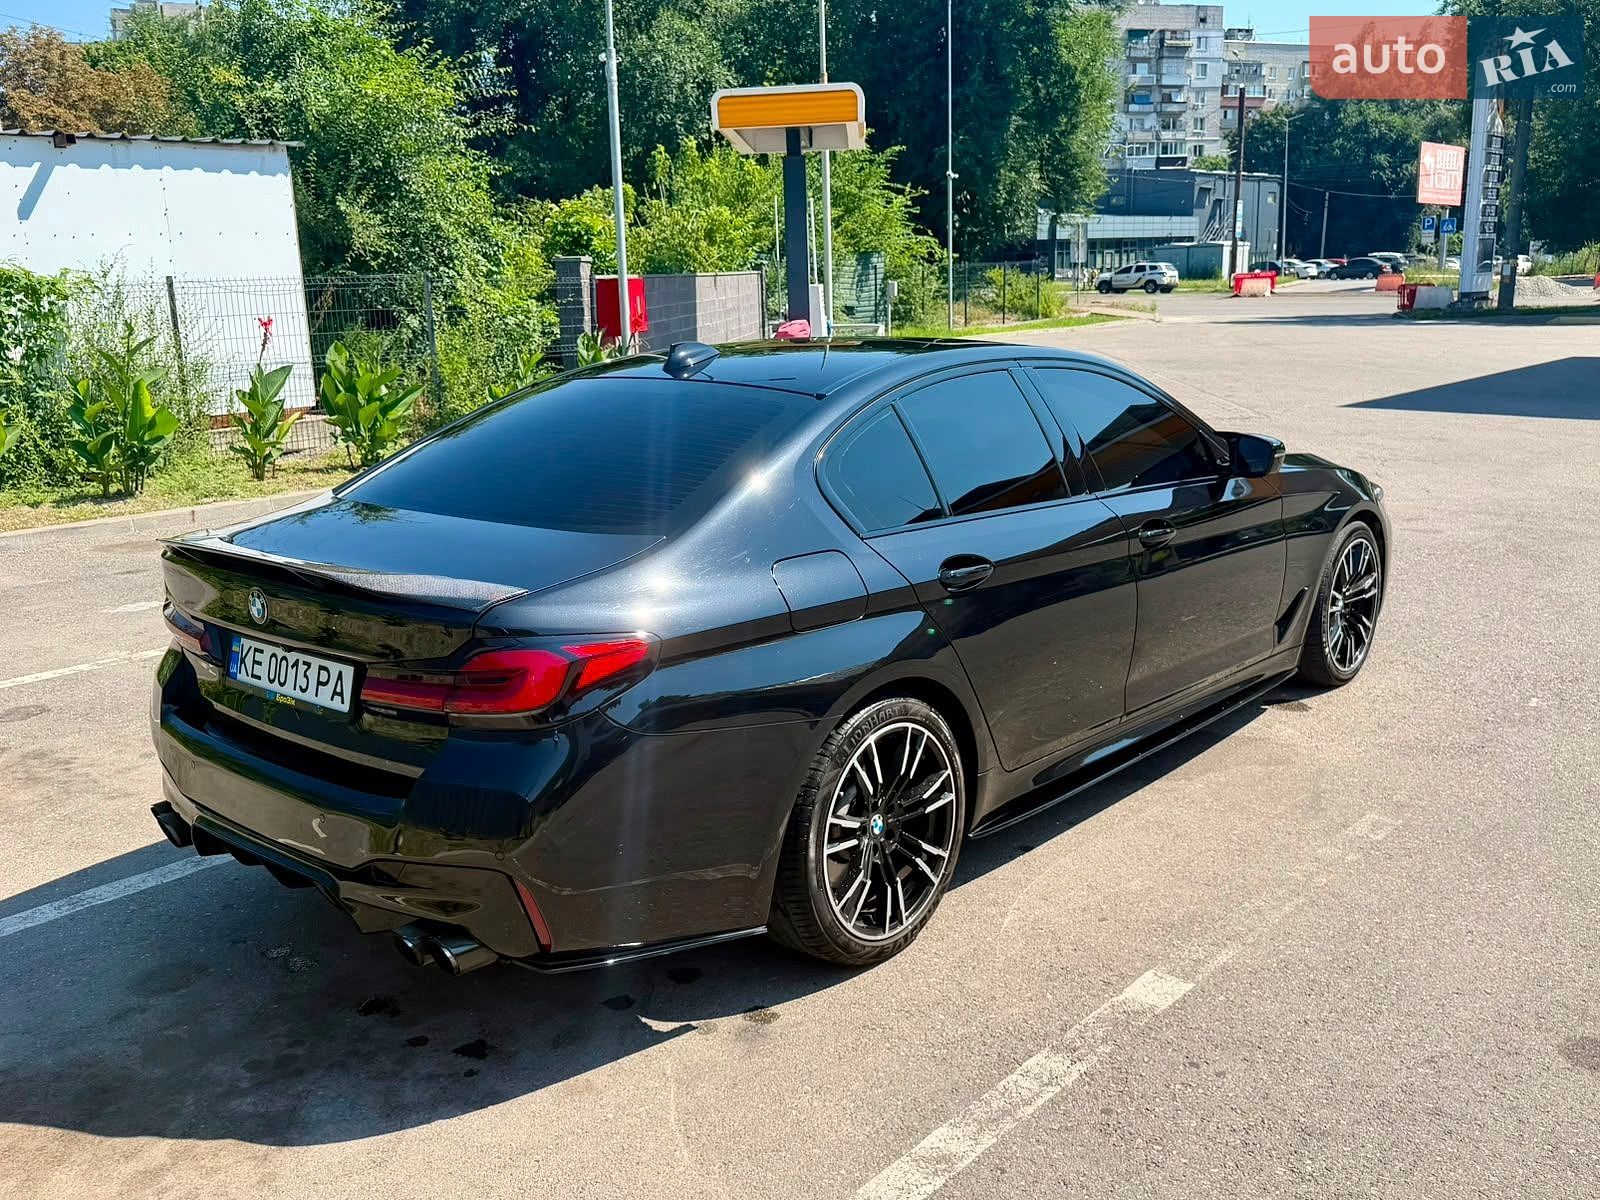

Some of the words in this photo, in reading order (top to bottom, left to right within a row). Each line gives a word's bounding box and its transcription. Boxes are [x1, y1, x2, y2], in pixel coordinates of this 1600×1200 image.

[1424, 218, 1433, 229] P
[239, 643, 265, 681] KE
[267, 652, 312, 694] 0013
[315, 664, 345, 705] PA
